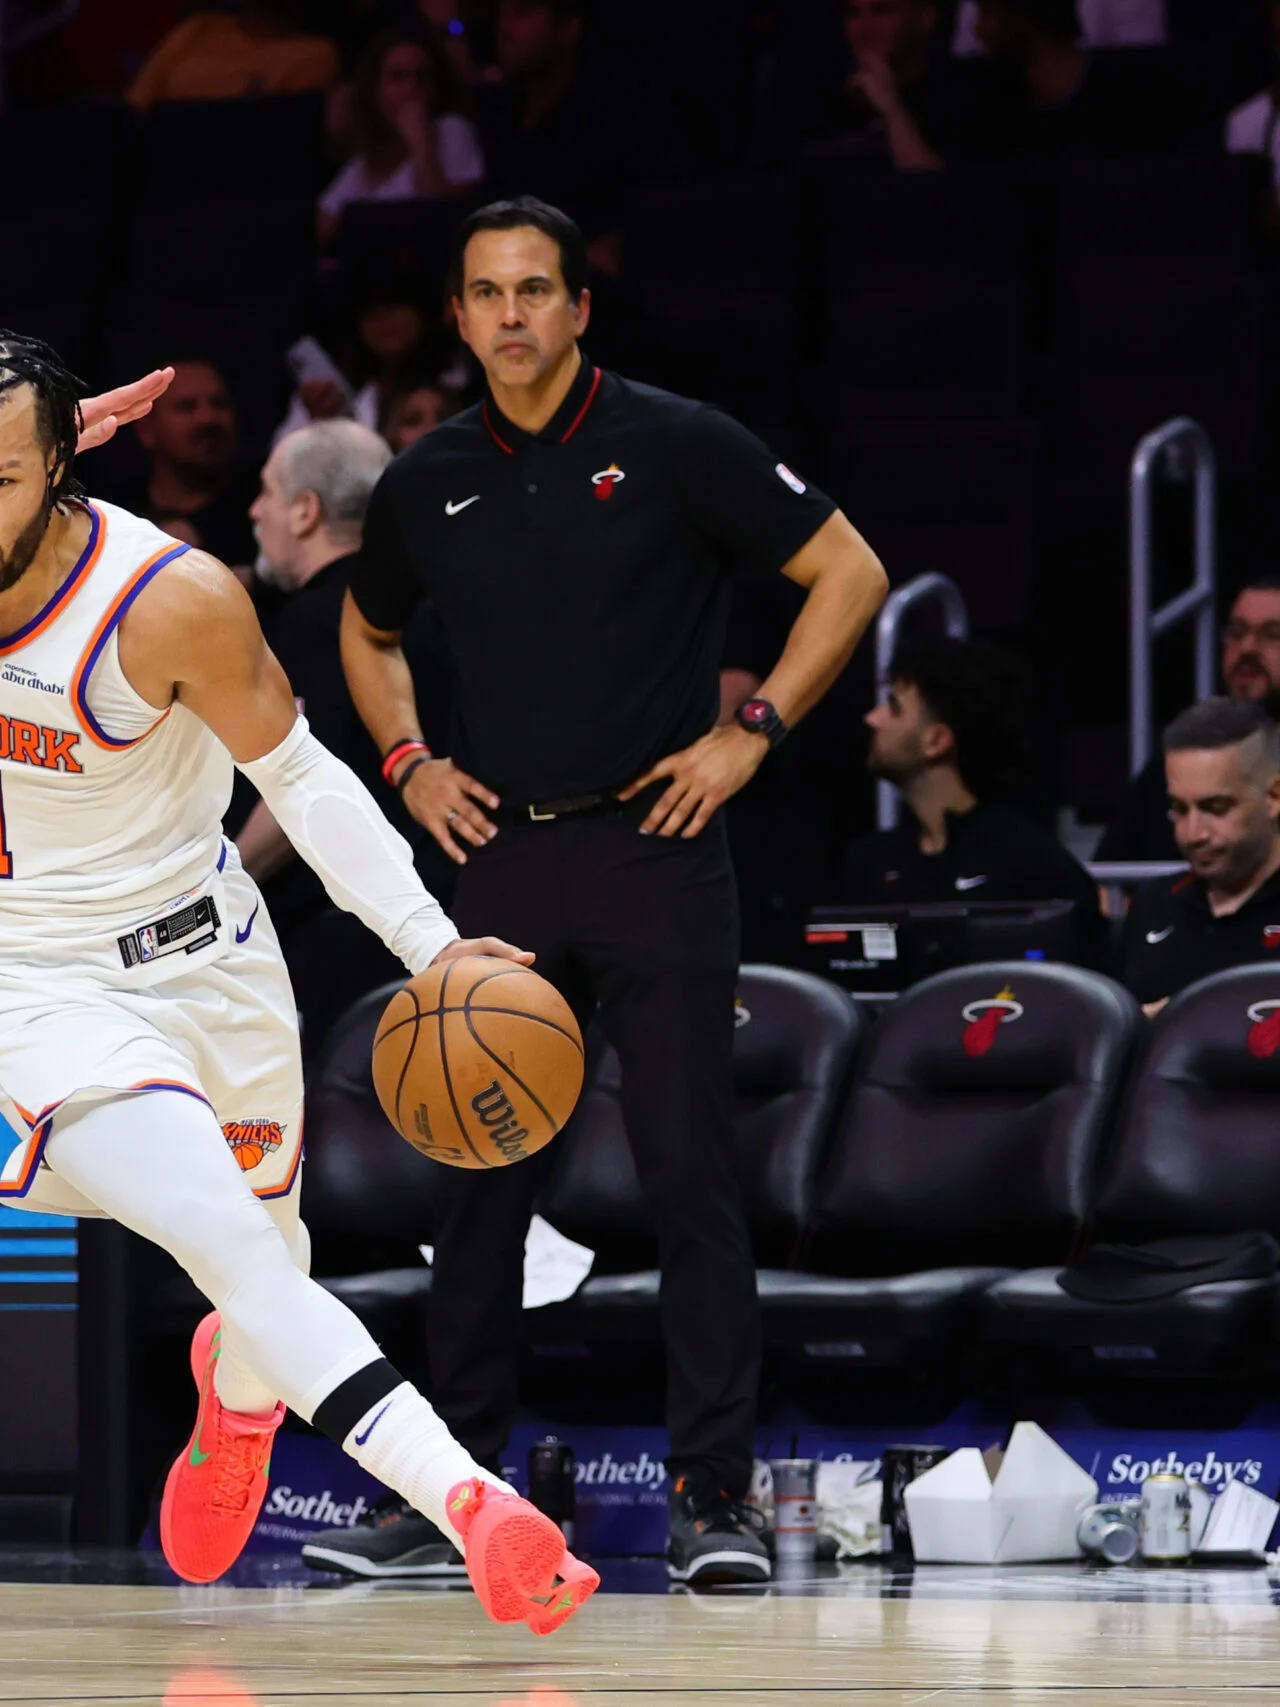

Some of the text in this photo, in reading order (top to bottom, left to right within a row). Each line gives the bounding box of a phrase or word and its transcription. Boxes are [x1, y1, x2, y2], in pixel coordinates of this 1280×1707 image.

[4, 662, 37, 677] experience
[1, 671, 64, 696] abu dhabi
[1107, 1451, 1263, 1491] Sotheby's
